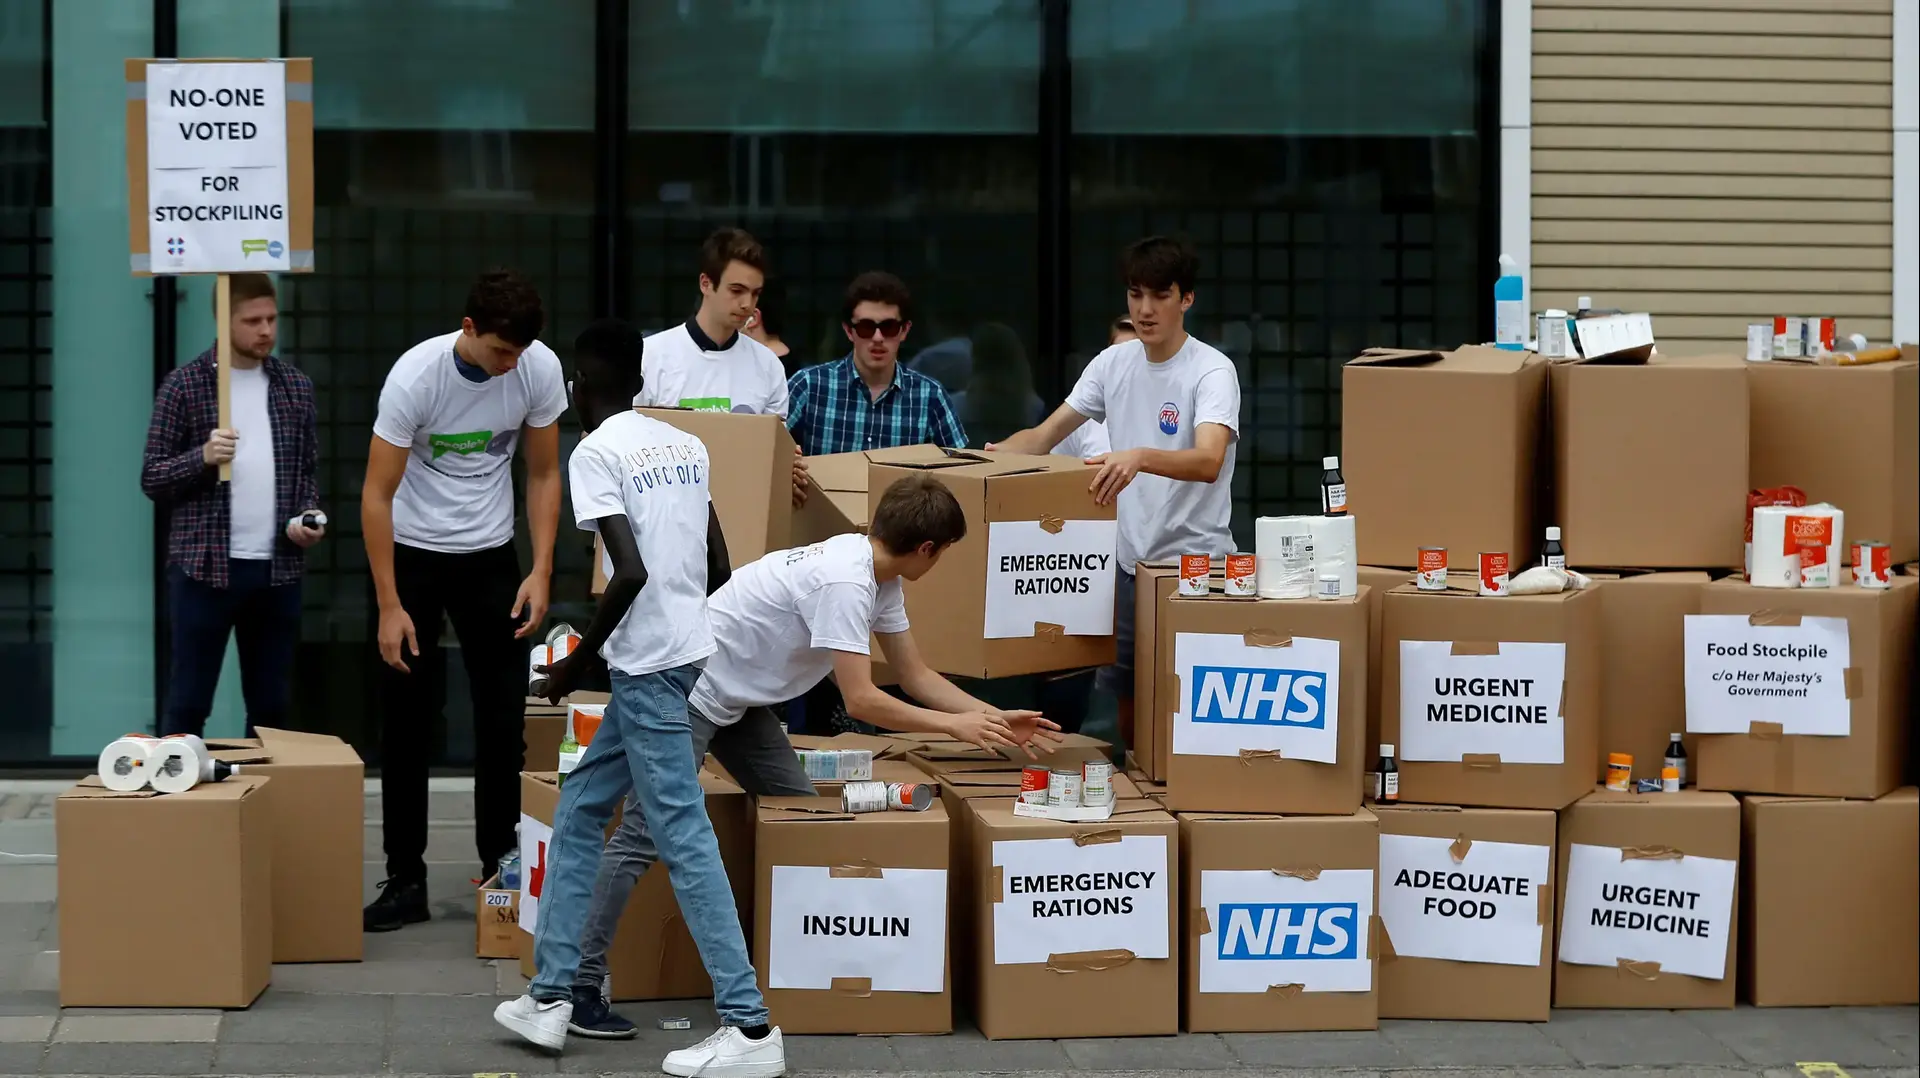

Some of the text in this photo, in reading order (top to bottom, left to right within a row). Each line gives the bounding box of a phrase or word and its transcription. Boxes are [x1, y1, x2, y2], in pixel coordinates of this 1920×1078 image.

[171, 89, 264, 107] NO-ONE
[179, 122, 256, 140] VOTED
[202, 176, 238, 191] FOR
[156, 205, 282, 221] STOCKPILING
[1001, 554, 1109, 572] EMERGENCY
[1015, 577, 1089, 595] RATIONS
[1708, 643, 1827, 661] Food Stockpile
[1712, 670, 1821, 685] c/o Her Majesty's
[1435, 678, 1534, 697] URGENT
[1728, 684, 1808, 697] Government
[1196, 672, 1322, 723] NHS
[1428, 704, 1547, 723] MEDICINE
[1011, 871, 1155, 893] EMERGENCY
[1394, 869, 1529, 896] ADEQUATE
[488, 895, 508, 906] 207
[1602, 883, 1700, 910] URGENT
[496, 907, 519, 923] SA
[1033, 896, 1133, 917] RATIONS
[1424, 897, 1496, 919] FOOD
[804, 915, 909, 936] INSULIN
[1222, 907, 1353, 955] NHS
[1591, 908, 1710, 938] MEDICINE
